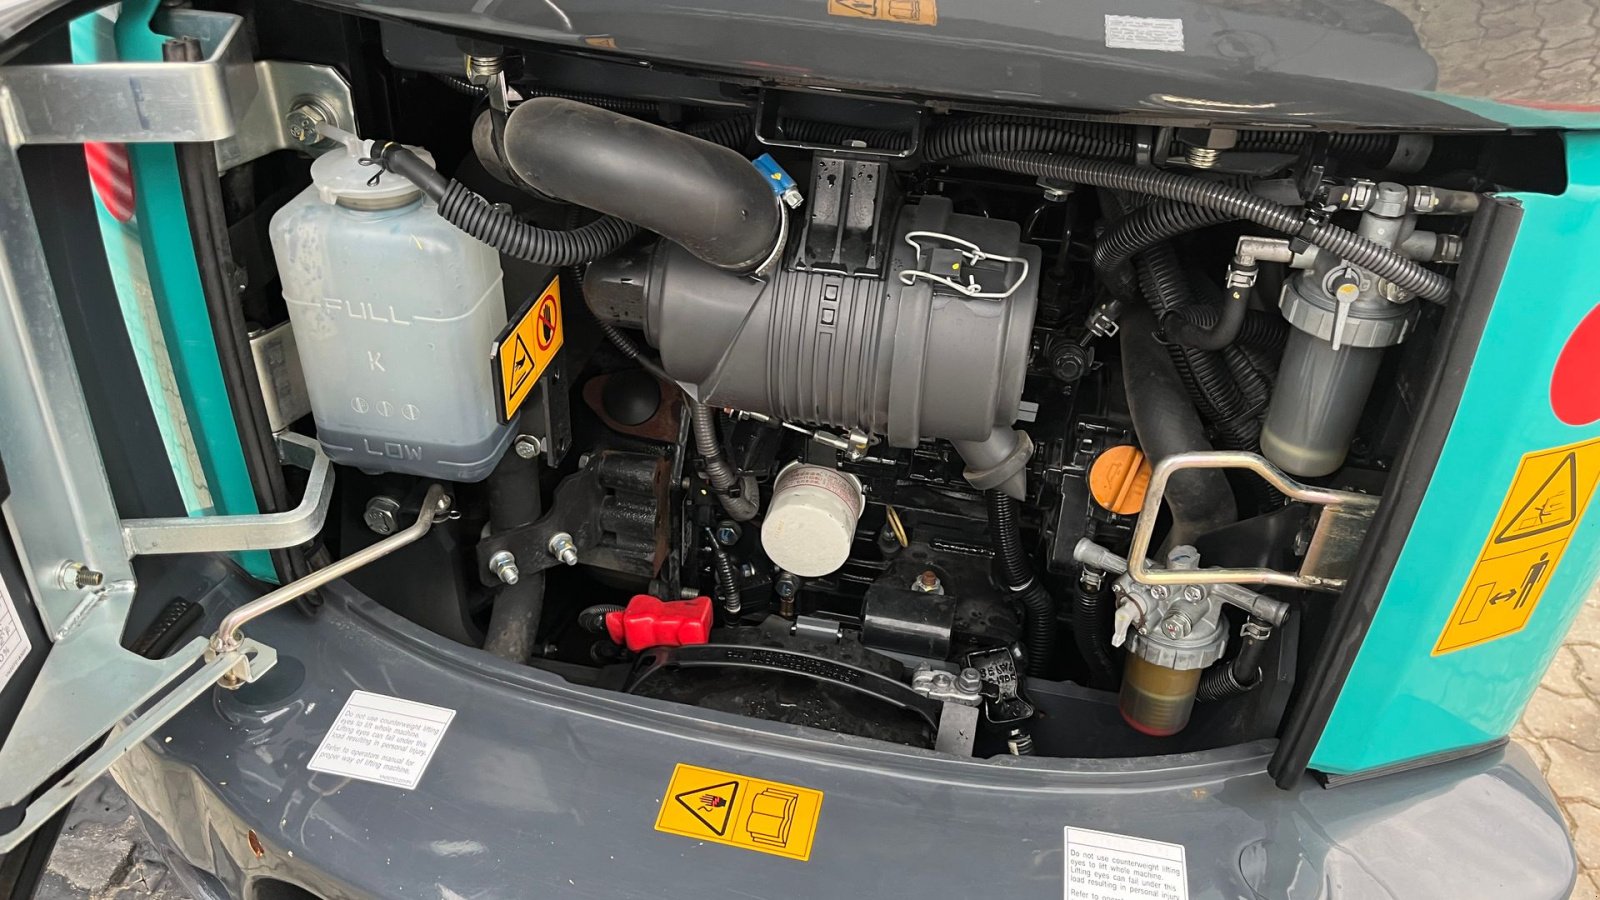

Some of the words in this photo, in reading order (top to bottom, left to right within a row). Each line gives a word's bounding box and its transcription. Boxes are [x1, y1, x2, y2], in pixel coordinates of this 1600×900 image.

[323, 298, 410, 325] FULL
[368, 351, 386, 372] K
[364, 438, 422, 460] LOW
[336, 726, 354, 734] Lifting
[380, 718, 421, 729] counterweight
[423, 726, 440, 736] lifting
[393, 728, 420, 738] machine.
[325, 743, 341, 751] Refer
[351, 749, 380, 759] operators
[382, 755, 405, 764] manual
[346, 735, 372, 746] resulting
[381, 742, 407, 751] personal
[409, 747, 427, 757] injury.
[320, 751, 340, 760] proper
[365, 759, 382, 769] lifting
[383, 764, 409, 774] machine.
[1070, 849, 1080, 857] Do
[1112, 857, 1159, 872] counterweight
[1162, 866, 1181, 877] lifting
[1071, 859, 1086, 867] eyes
[1099, 862, 1107, 870] lift
[1111, 866, 1130, 875] whole
[1134, 869, 1164, 881] machine.
[1070, 866, 1091, 878] Lifting
[1094, 870, 1110, 879] eyes
[1113, 874, 1126, 882] can
[1128, 875, 1139, 885] fail
[1142, 879, 1161, 889] under
[1164, 883, 1177, 892] this
[1070, 875, 1085, 884] load
[1088, 878, 1118, 891] resulting
[1130, 886, 1159, 897] personal
